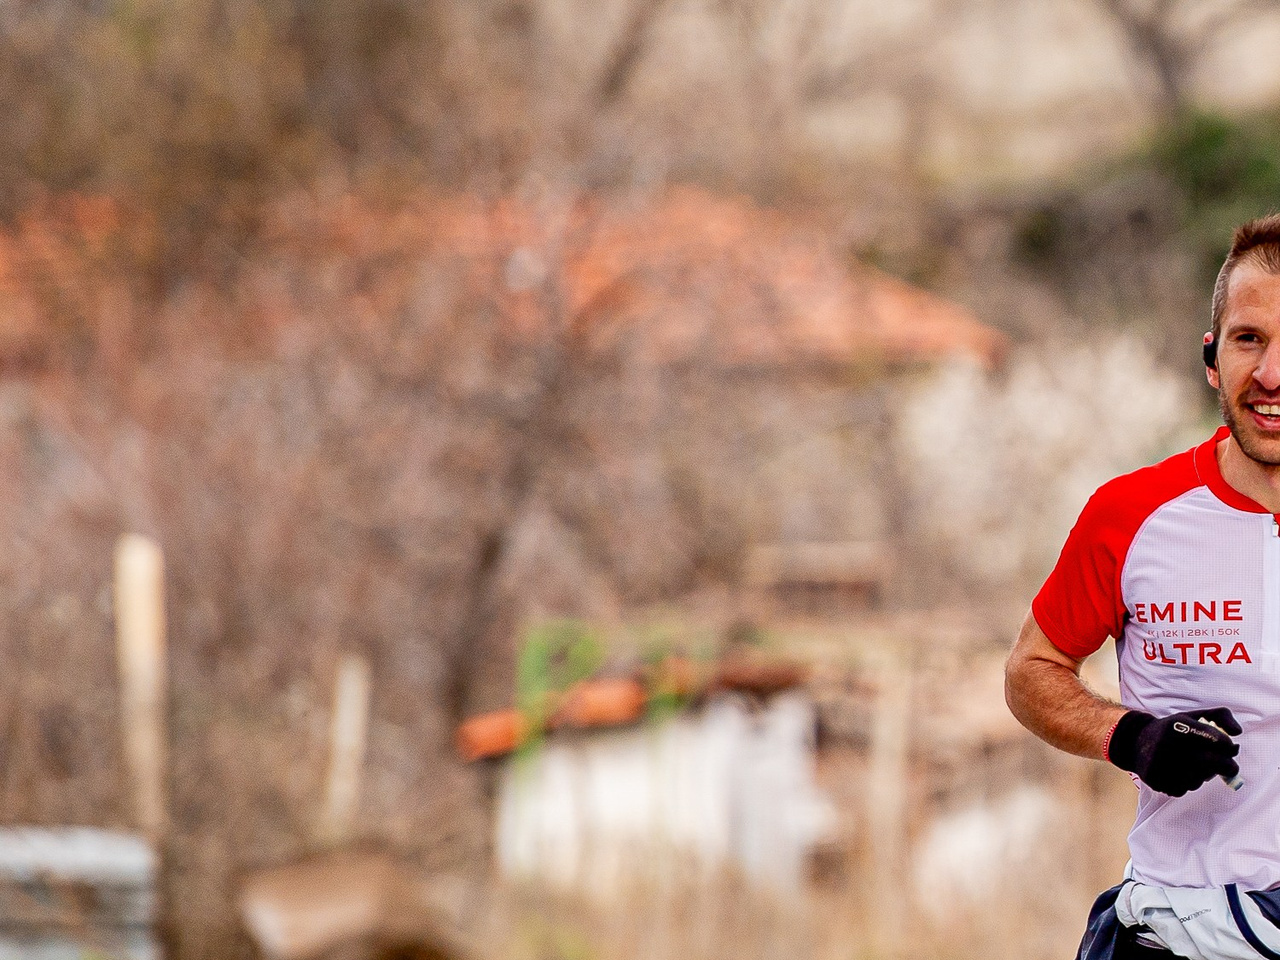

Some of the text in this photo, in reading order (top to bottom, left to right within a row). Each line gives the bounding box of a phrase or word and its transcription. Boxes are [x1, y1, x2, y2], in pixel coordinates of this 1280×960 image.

[1135, 600, 1243, 623] EMINE
[1162, 630, 1178, 638] 12K
[1187, 629, 1208, 637] 28K
[1218, 628, 1240, 636] 50K
[1143, 639, 1252, 665] ULTRA
